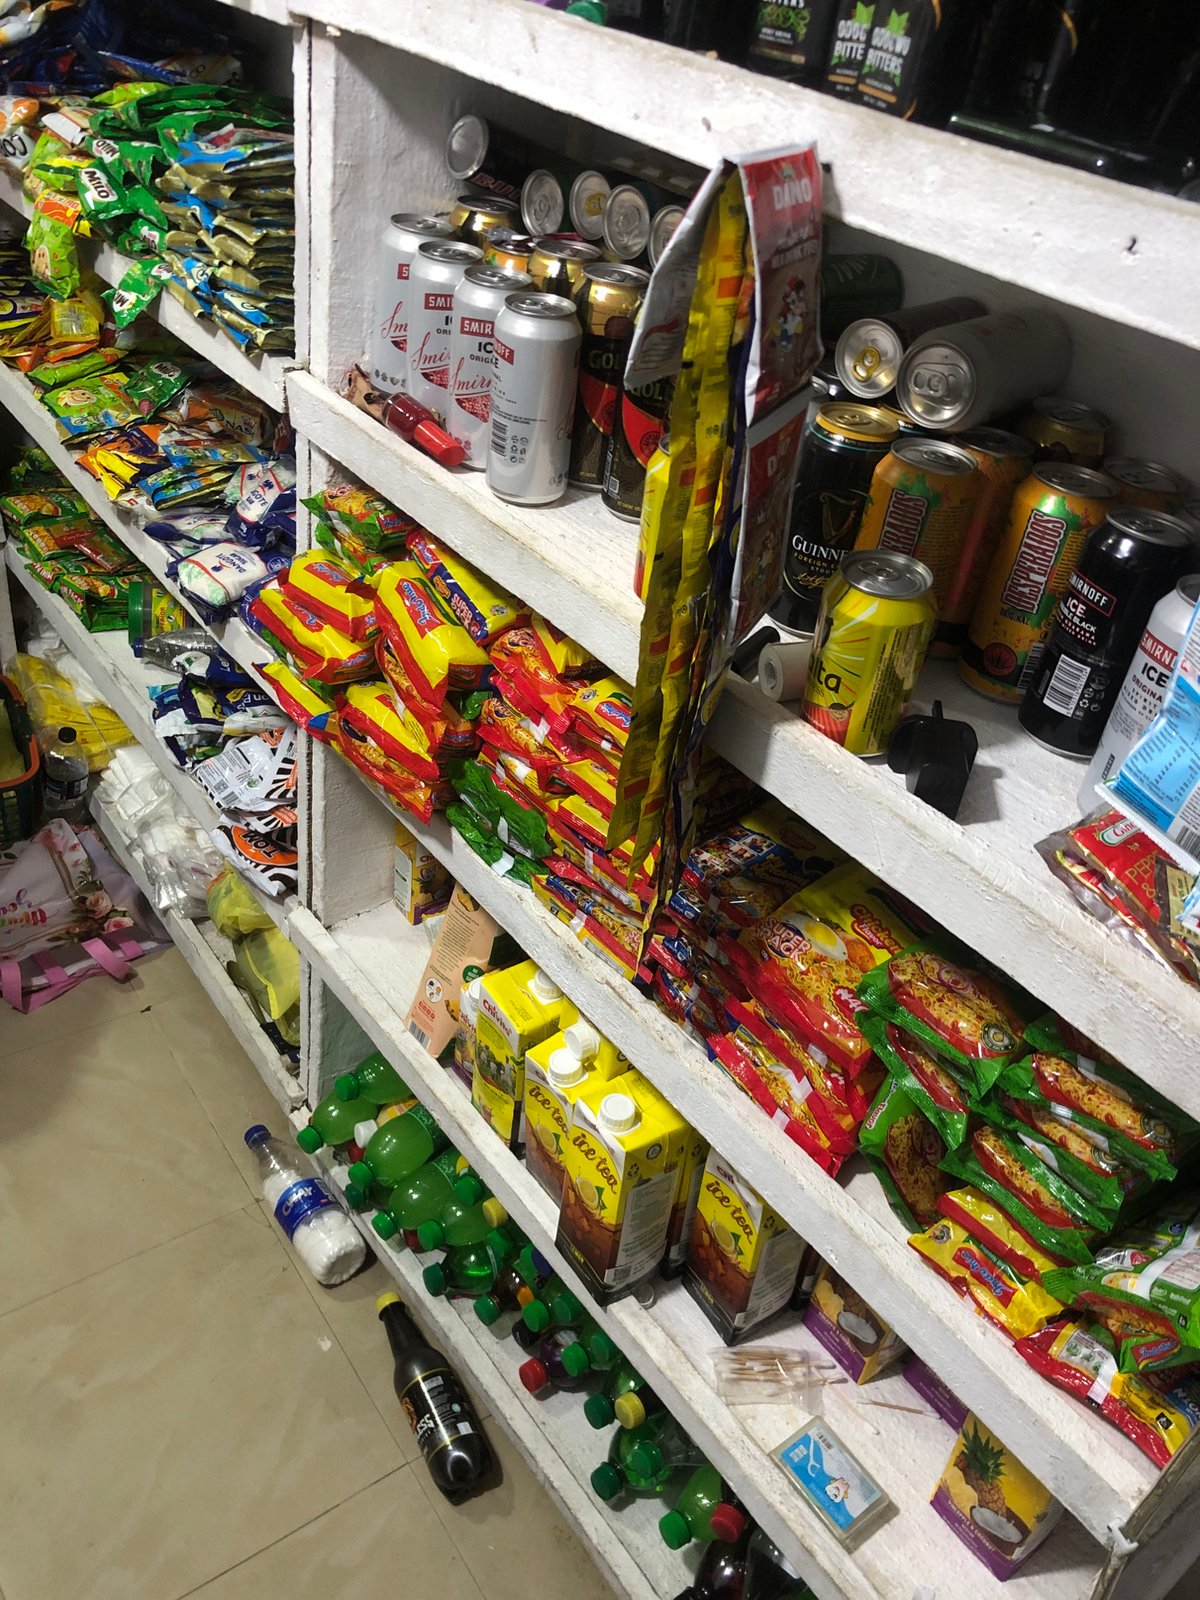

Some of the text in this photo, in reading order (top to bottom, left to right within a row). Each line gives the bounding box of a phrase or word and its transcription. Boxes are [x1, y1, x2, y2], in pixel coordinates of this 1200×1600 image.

[871, 26, 912, 56] ODOGWU
[866, 48, 904, 75] BITTERS
[84, 170, 110, 199] MILO
[772, 176, 813, 212] DANO
[877, 488, 928, 557] ERADOS
[792, 534, 849, 561] GUINNE
[1001, 509, 1067, 615] DESPERADOS
[215, 552, 247, 574] DANGOTE
[401, 580, 434, 626] Indomie
[1066, 596, 1087, 617] ICE
[1072, 616, 1097, 633] BLACK
[1141, 662, 1170, 689] ICE
[240, 830, 278, 860] TOM
[767, 917, 812, 954] SUPER
[528, 1085, 571, 1141] ice tea
[865, 1102, 888, 1130] Flavor
[572, 1133, 618, 1195] ice tea
[706, 1180, 753, 1245] ice tea
